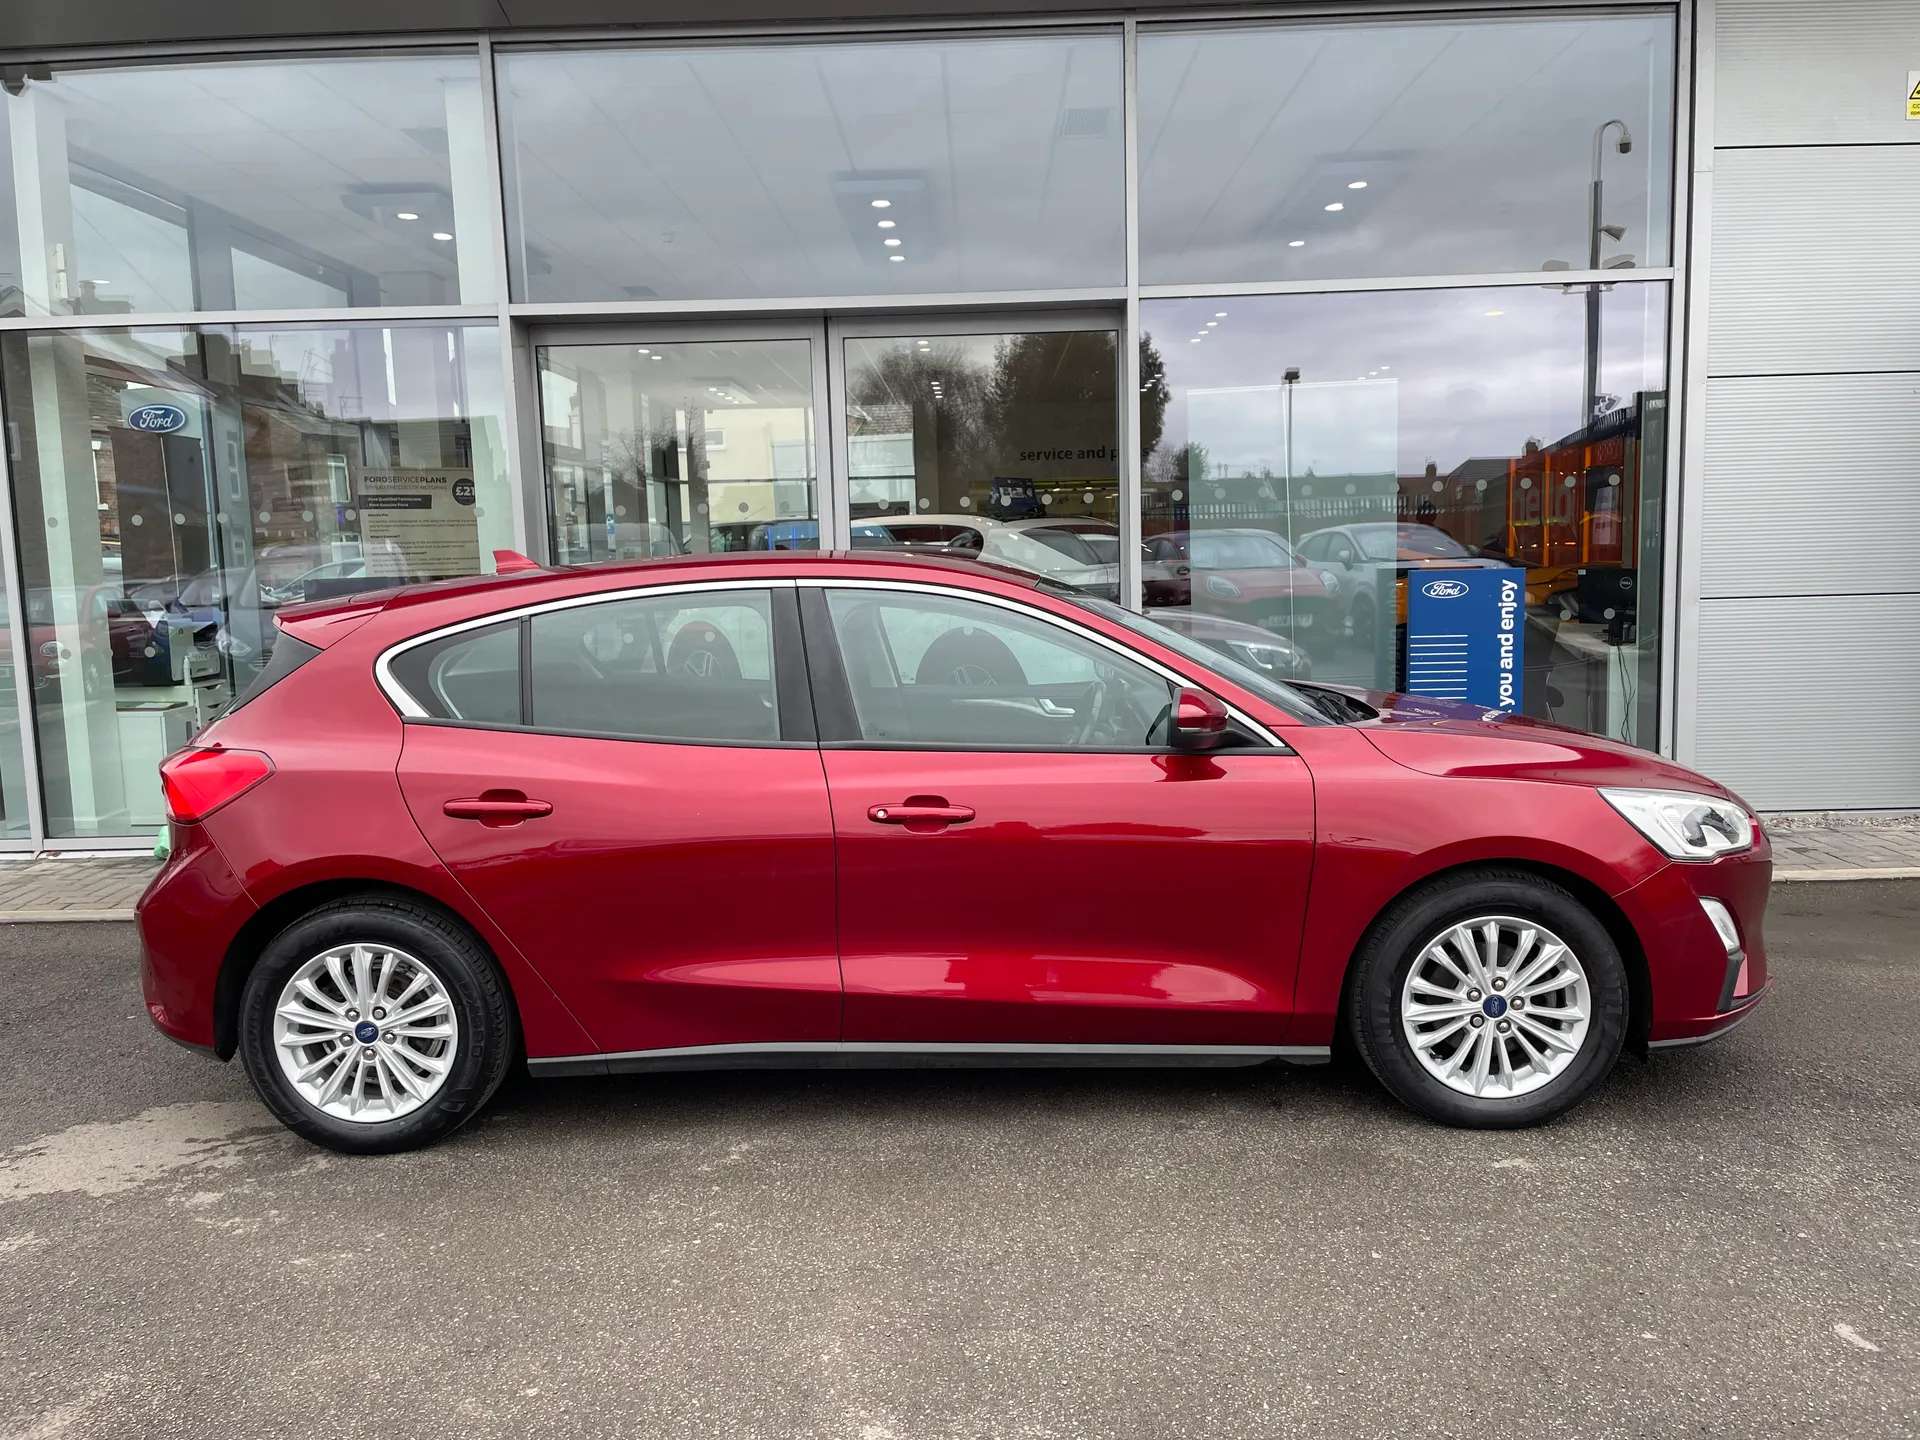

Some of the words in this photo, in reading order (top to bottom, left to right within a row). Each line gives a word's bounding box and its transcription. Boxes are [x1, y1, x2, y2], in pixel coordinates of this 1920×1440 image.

[140, 409, 174, 428] Ford
[1020, 447, 1073, 461] service
[1077, 446, 1105, 459] and
[1430, 582, 1461, 596] Ford
[1498, 579, 1517, 631] enjoy
[1497, 634, 1513, 670] and
[1499, 673, 1515, 706] you
